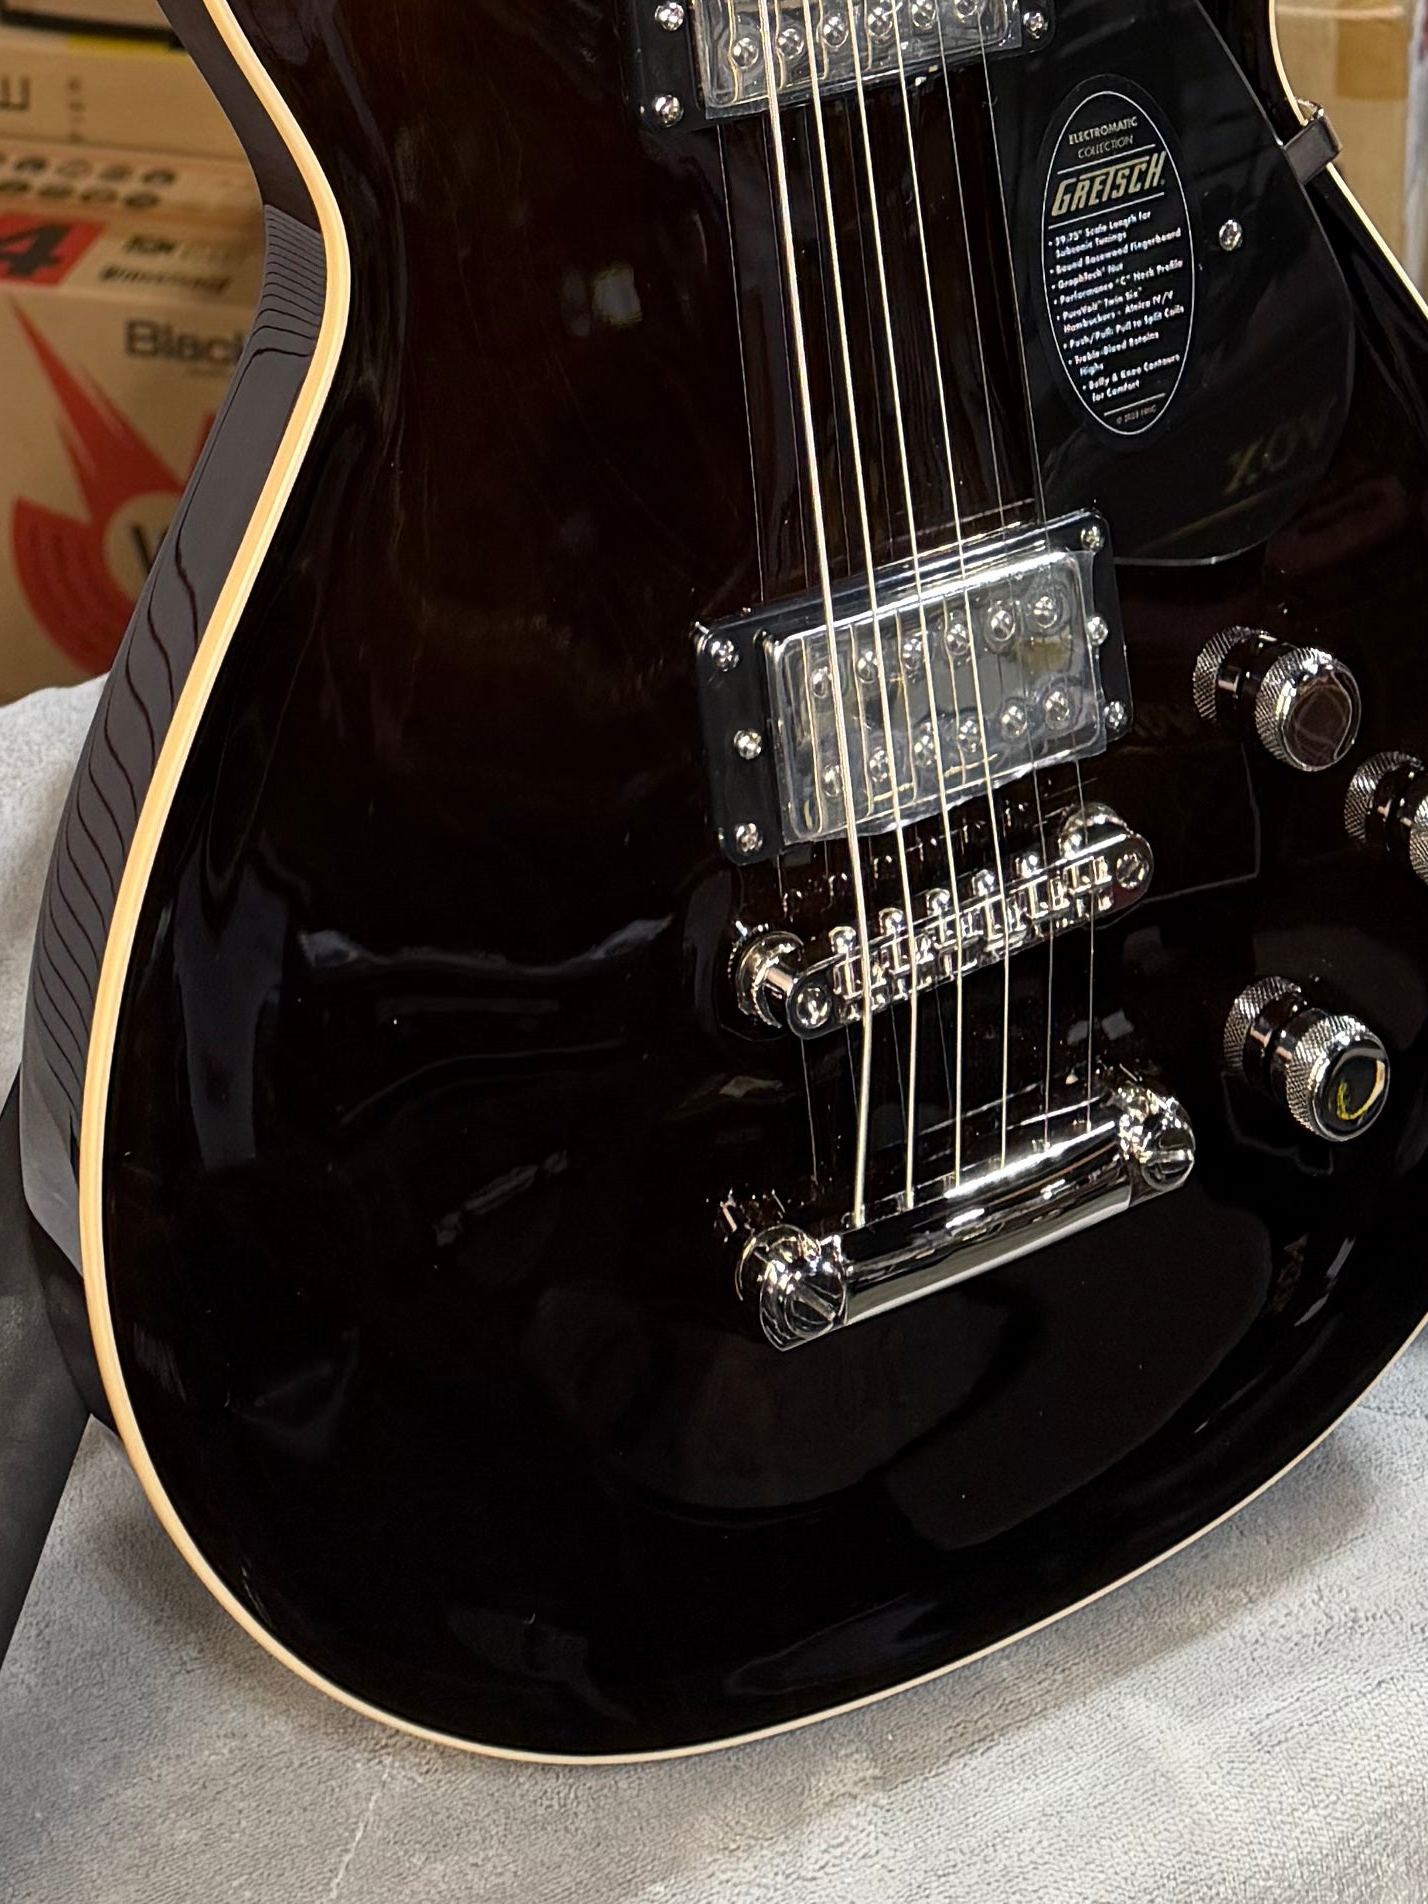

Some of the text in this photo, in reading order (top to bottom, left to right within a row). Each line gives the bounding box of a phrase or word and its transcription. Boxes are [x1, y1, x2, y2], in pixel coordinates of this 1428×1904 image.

[1068, 116, 1138, 145] ELECTROMATIC
[1077, 135, 1134, 159] COLLECTION
[1051, 150, 1167, 217] GRETSCH
